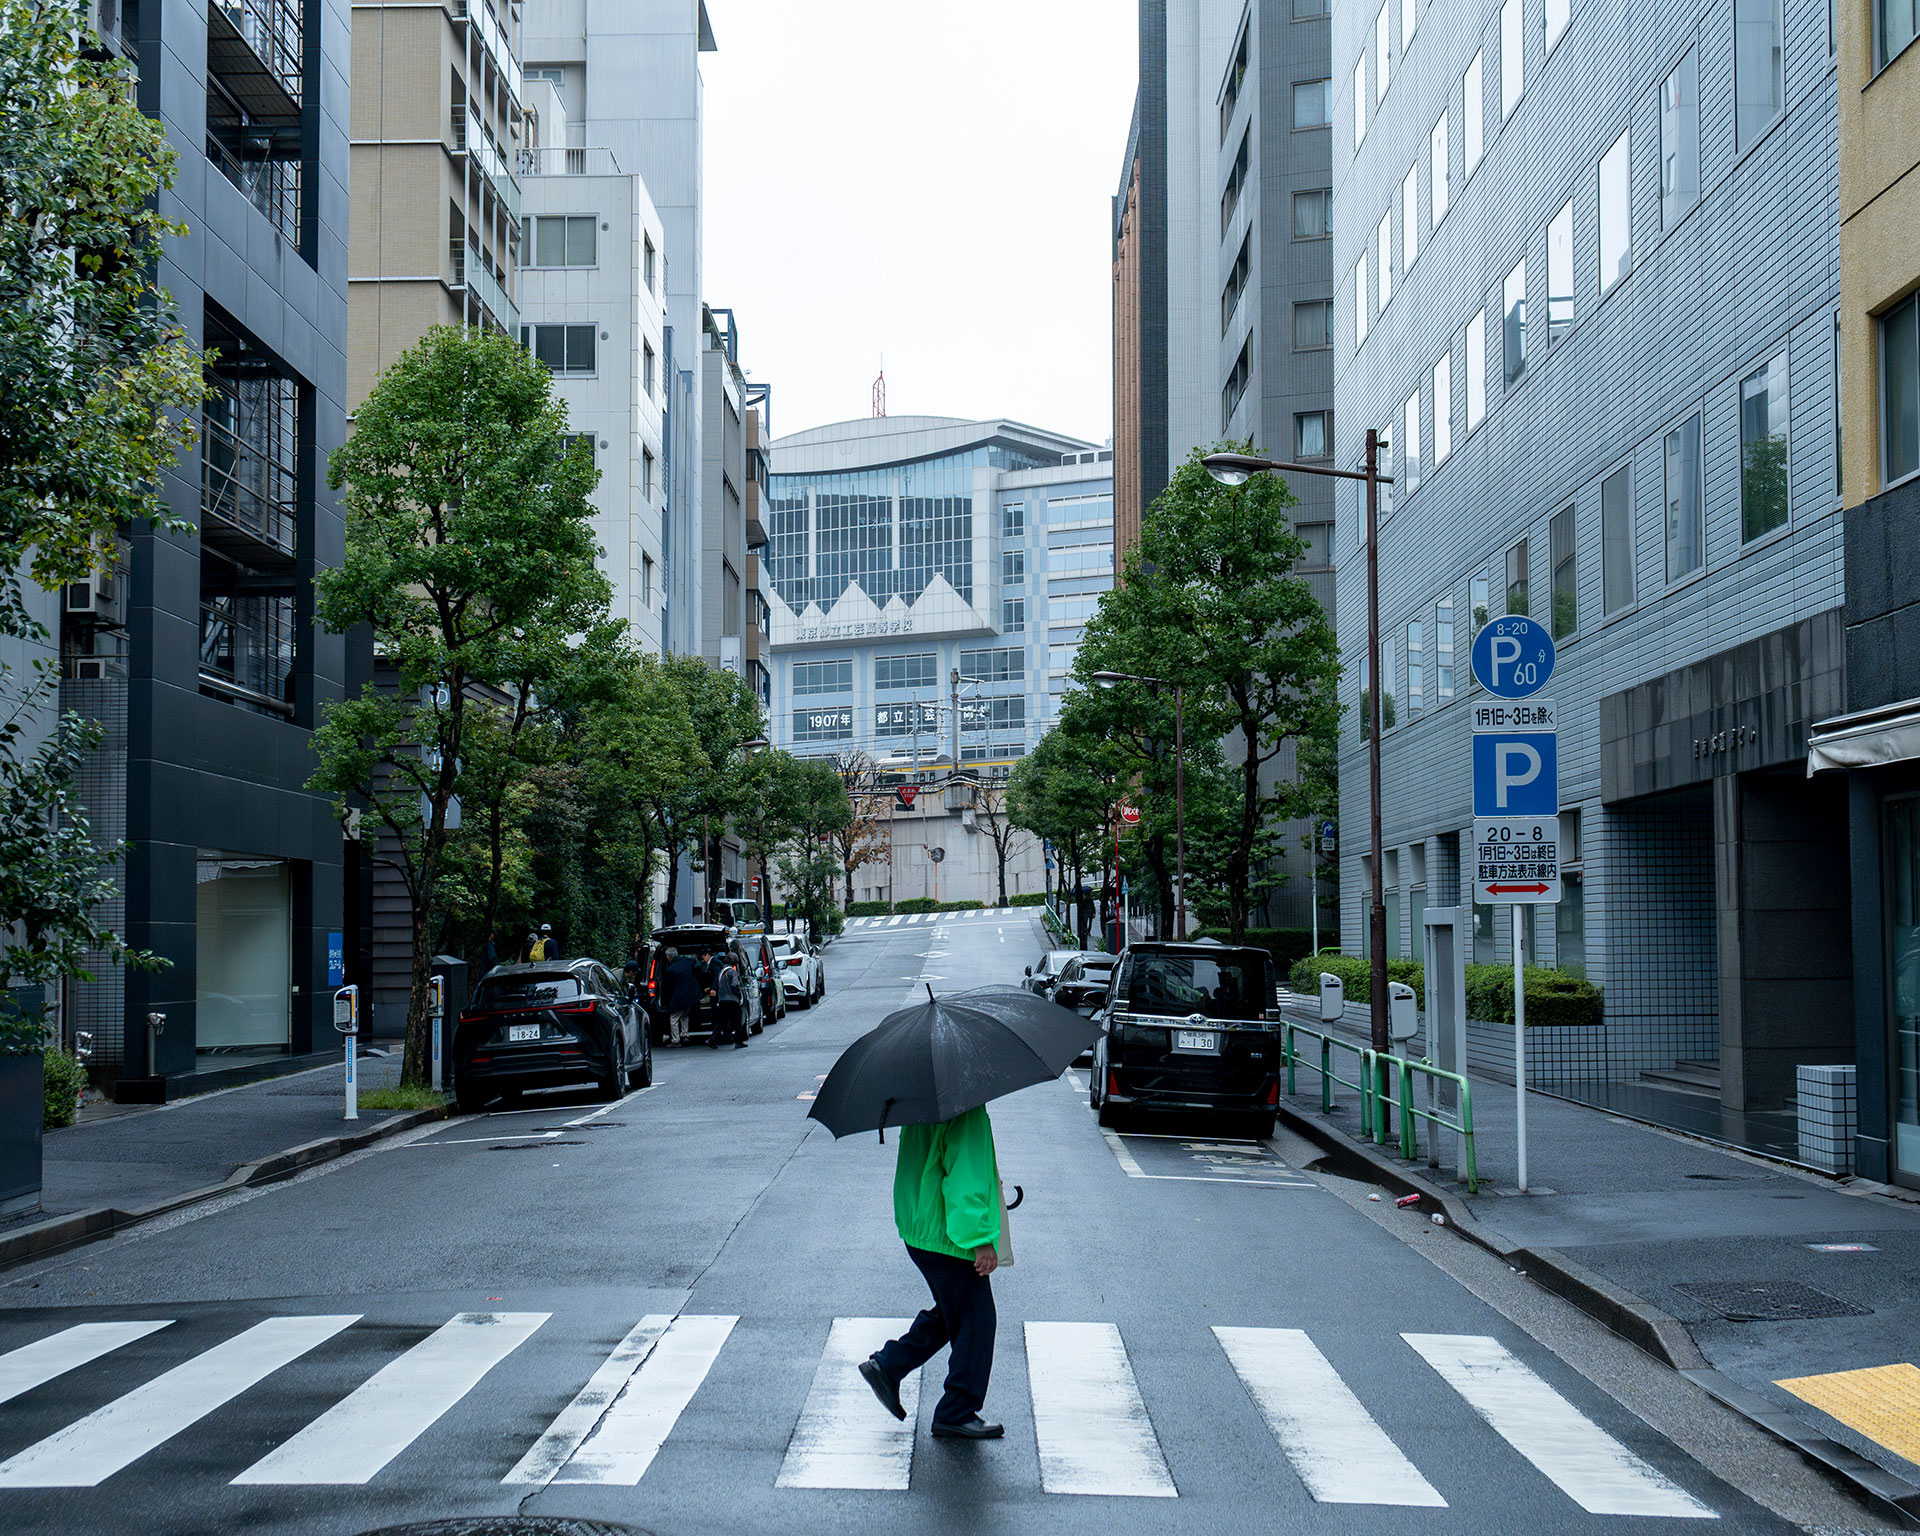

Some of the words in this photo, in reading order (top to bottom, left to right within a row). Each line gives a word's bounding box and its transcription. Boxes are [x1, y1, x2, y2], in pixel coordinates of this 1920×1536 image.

[796, 619, 913, 640] 東京都立工芸高等学校
[1497, 622, 1528, 636] 8-20
[1491, 636, 1521, 687] P
[809, 714, 851, 728] 1907年
[1475, 706, 1554, 726] 1月1日～3日を除く
[1496, 742, 1542, 808] P
[1478, 844, 1556, 860] 1月1日～3日は終日
[1478, 863, 1557, 879] 駐車方法表示線内
[517, 1030, 538, 1039] 18-24
